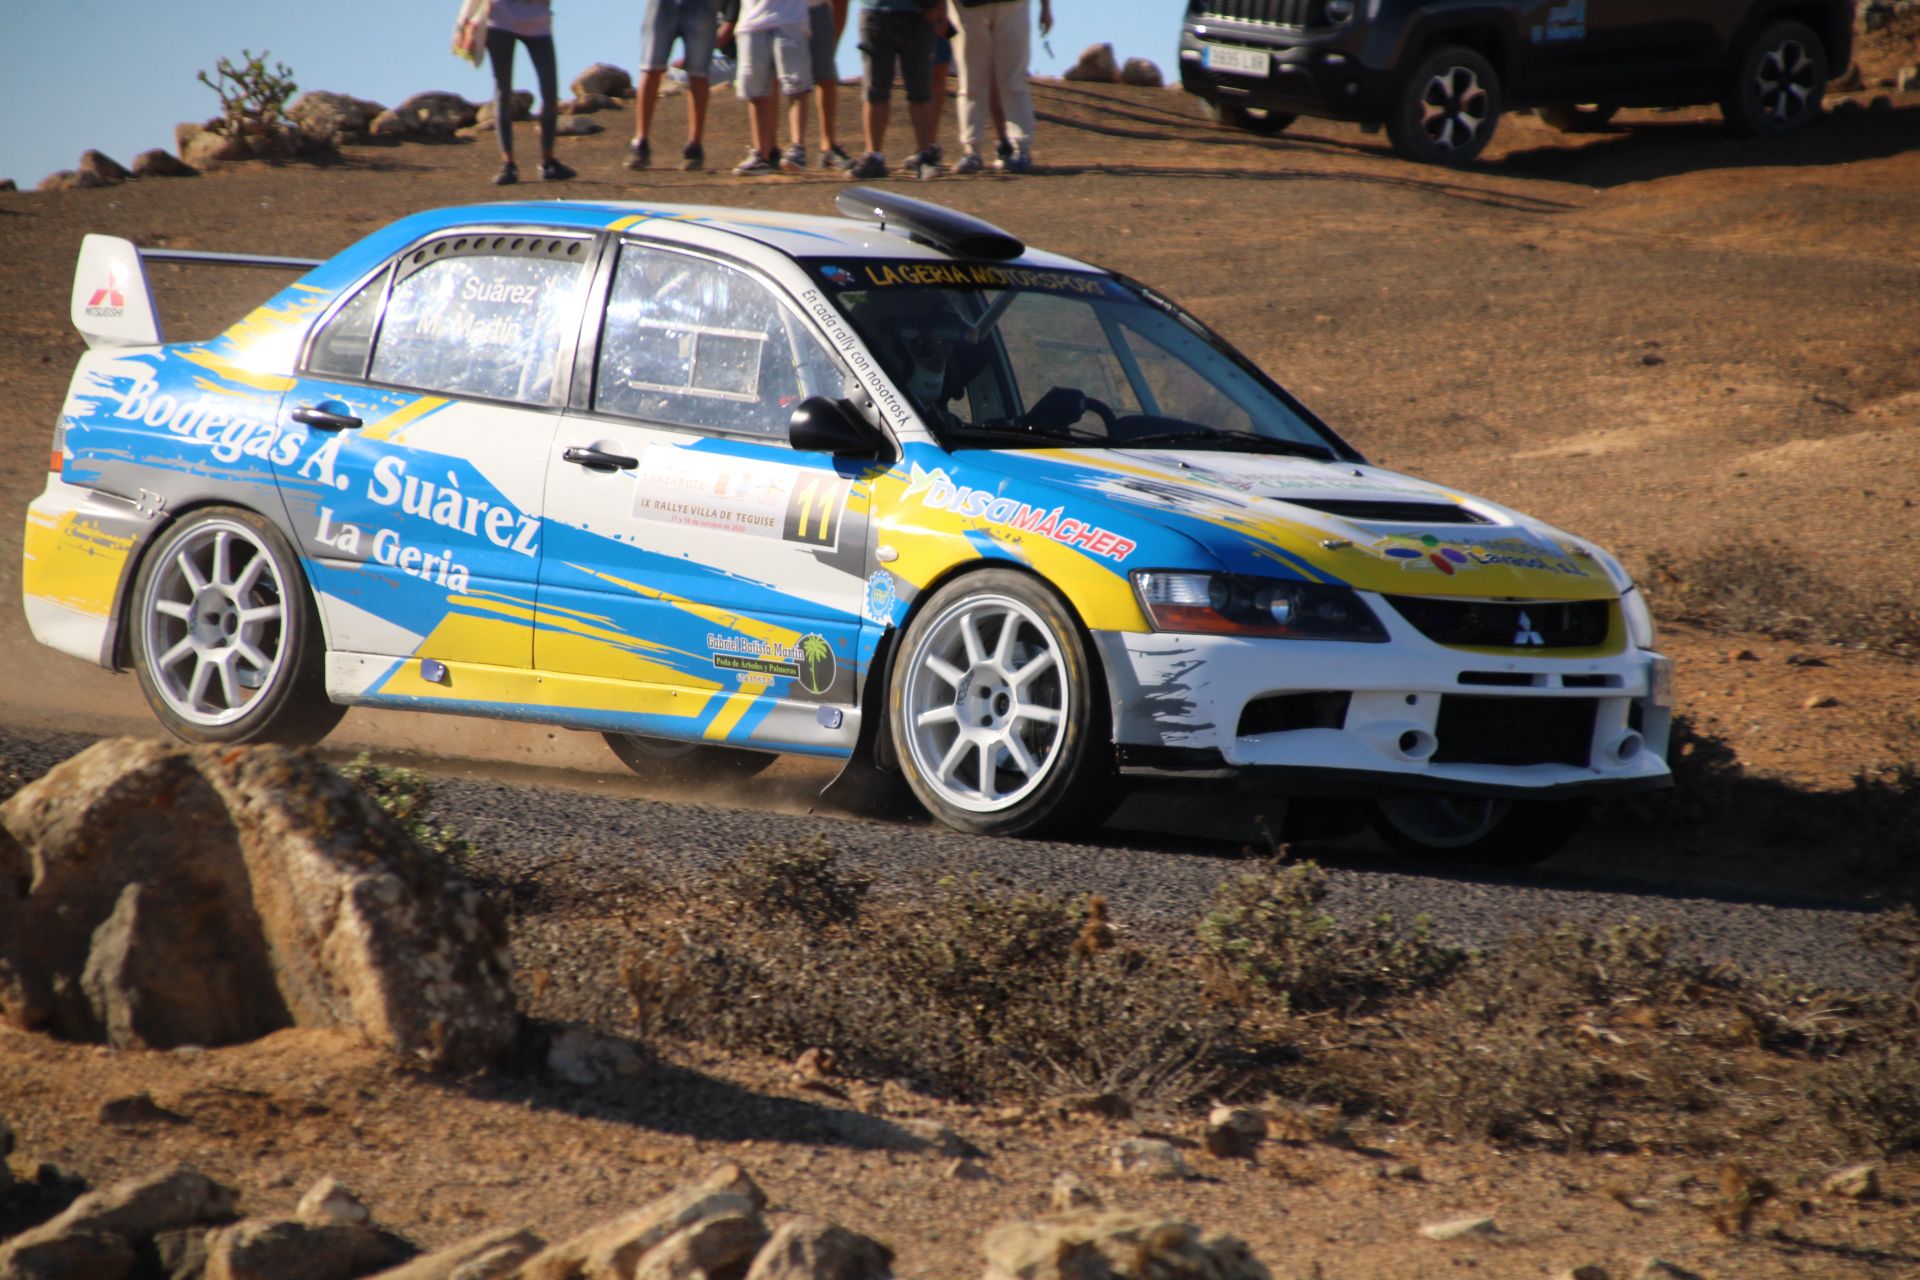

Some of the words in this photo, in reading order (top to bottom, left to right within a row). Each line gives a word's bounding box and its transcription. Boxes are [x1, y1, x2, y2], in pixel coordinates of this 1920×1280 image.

[865, 265, 900, 285] LA
[899, 264, 971, 284] GERIA
[971, 266, 1107, 296] MOTORSPORT
[802, 289, 818, 304] En
[813, 301, 837, 328] cada
[832, 326, 855, 352] rally
[851, 351, 870, 371] con
[866, 371, 906, 418] nosotros
[113, 374, 308, 466] Bodegas
[640, 498, 651, 508] IX
[654, 500, 689, 514] RALLYE
[691, 505, 718, 518] VILLA
[719, 509, 732, 520] DE
[735, 512, 776, 527] TEGUISE
[796, 477, 841, 541] 11
[315, 507, 361, 555] La
[372, 528, 470, 594] Geria
[707, 633, 739, 652] Gabriel
[741, 637, 771, 656] Batista
[716, 657, 731, 667] Poda
[732, 658, 739, 667] de
[769, 663, 797, 675] Palmeras
